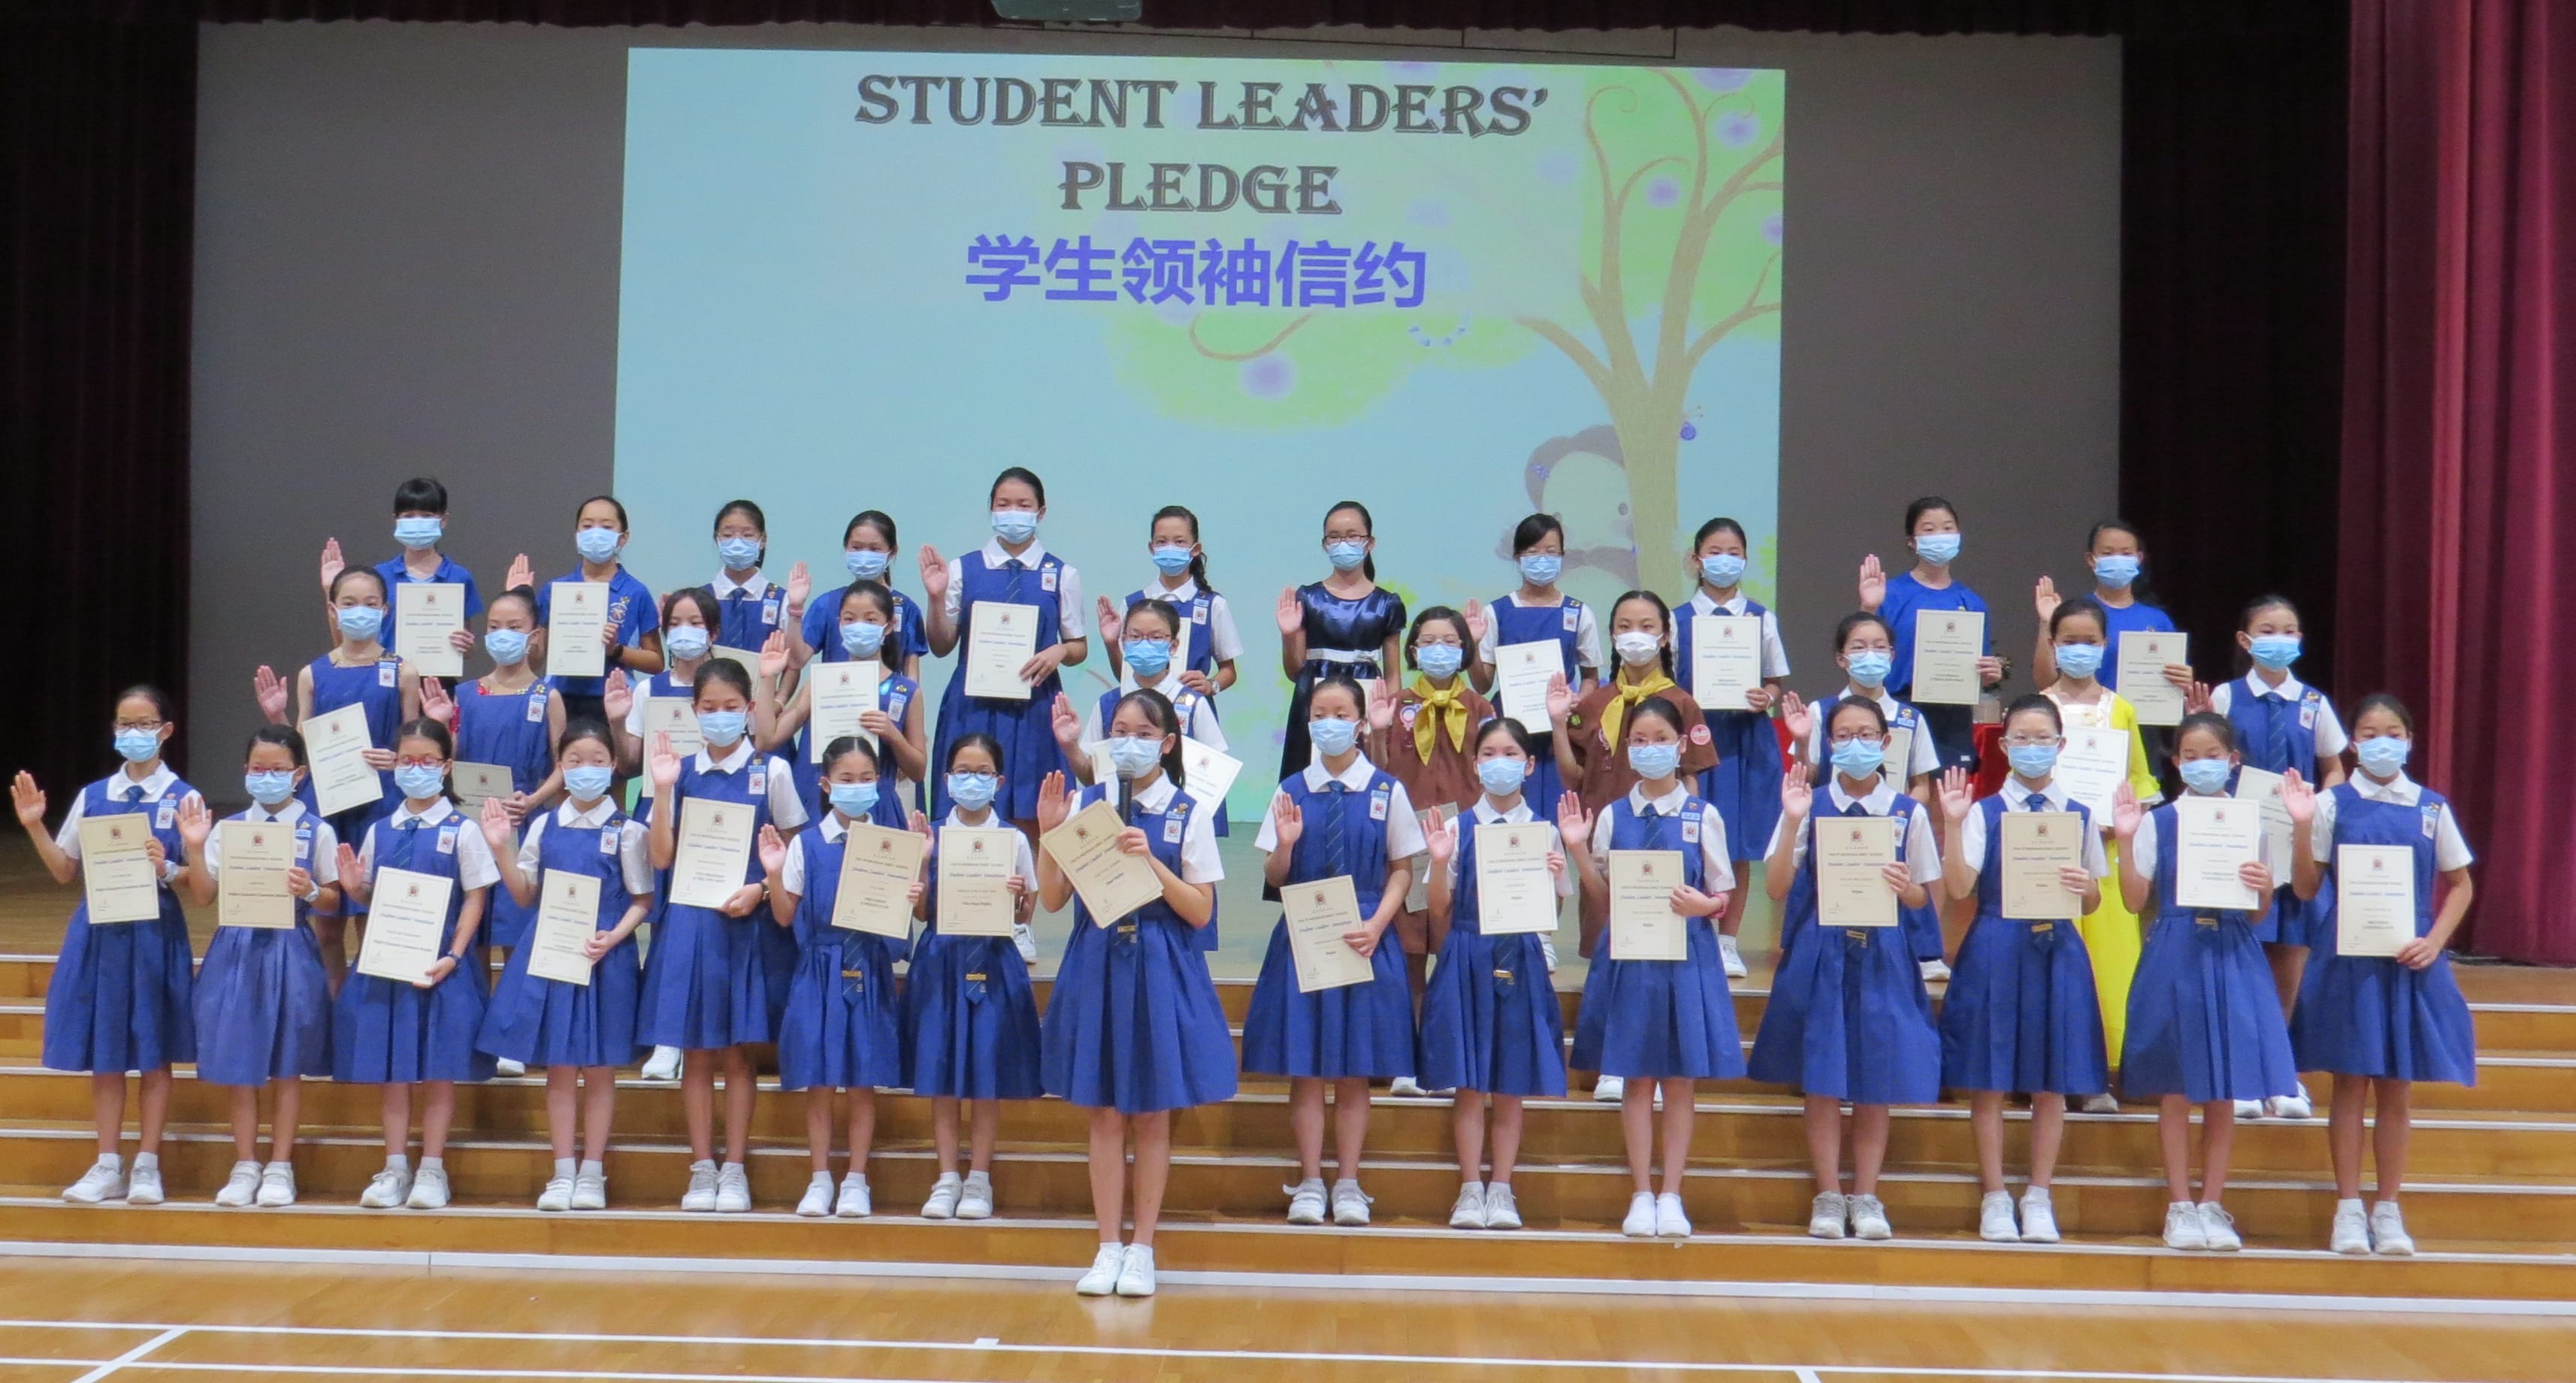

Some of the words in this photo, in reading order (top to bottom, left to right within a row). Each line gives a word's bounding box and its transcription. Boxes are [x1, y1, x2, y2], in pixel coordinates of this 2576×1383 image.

[854, 74, 1180, 129] STUDENT
[1058, 161, 1342, 214] PLEDGE
[966, 235, 1427, 308] 学生领袖信约
